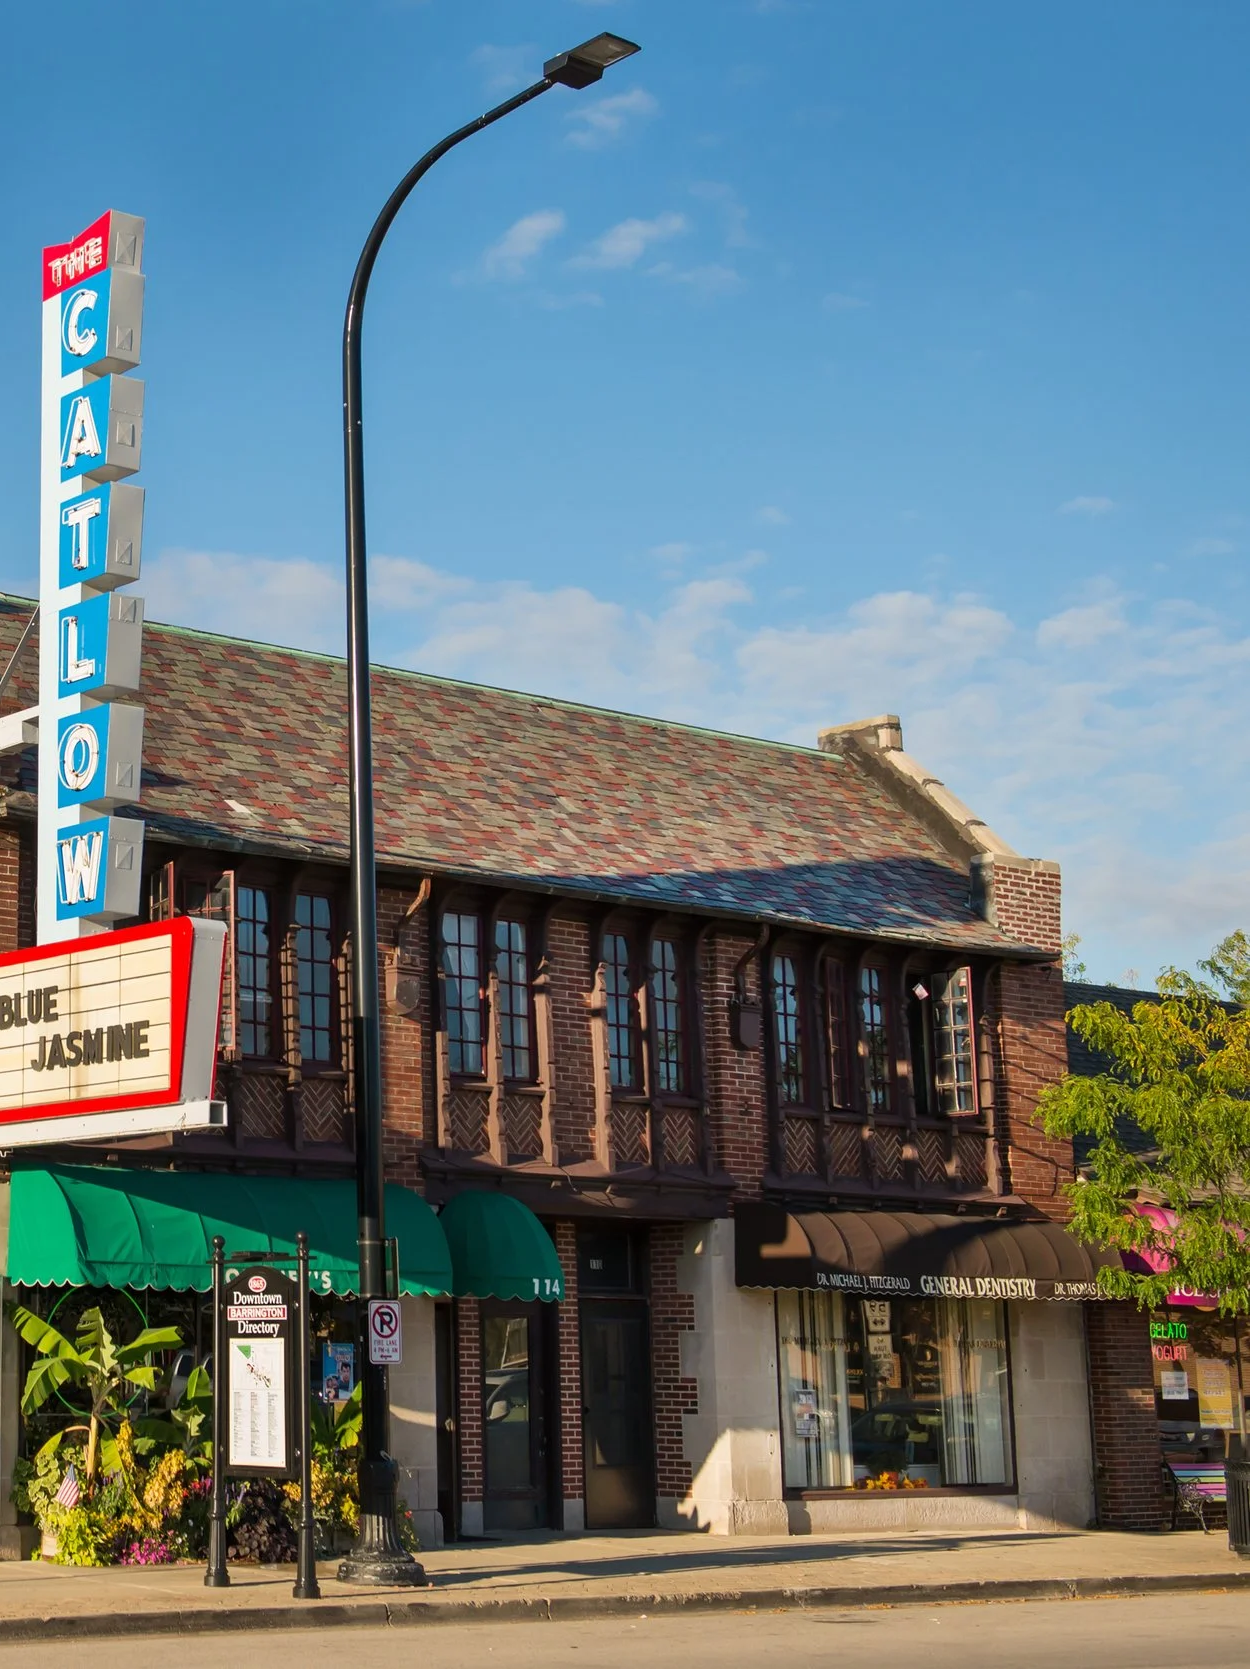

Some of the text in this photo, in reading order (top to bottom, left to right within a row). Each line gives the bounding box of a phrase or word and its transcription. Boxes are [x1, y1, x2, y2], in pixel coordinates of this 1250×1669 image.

[47, 236, 103, 287] THE
[56, 288, 104, 905] CATLOW
[31, 1020, 150, 1072] JASMINE
[533, 1277, 561, 1296] 114
[830, 1273, 863, 1287] MICHAEL
[869, 1276, 911, 1290] FITZGERALD
[920, 1275, 1037, 1301] GENERAL DENTISTRY
[1066, 1282, 1096, 1296] THOMAS
[233, 1291, 283, 1306] Downtown
[229, 1308, 283, 1319] BARRINGTON
[237, 1320, 280, 1338] Directory
[1150, 1322, 1188, 1339] GELATO
[1151, 1344, 1188, 1361] YOGURT
